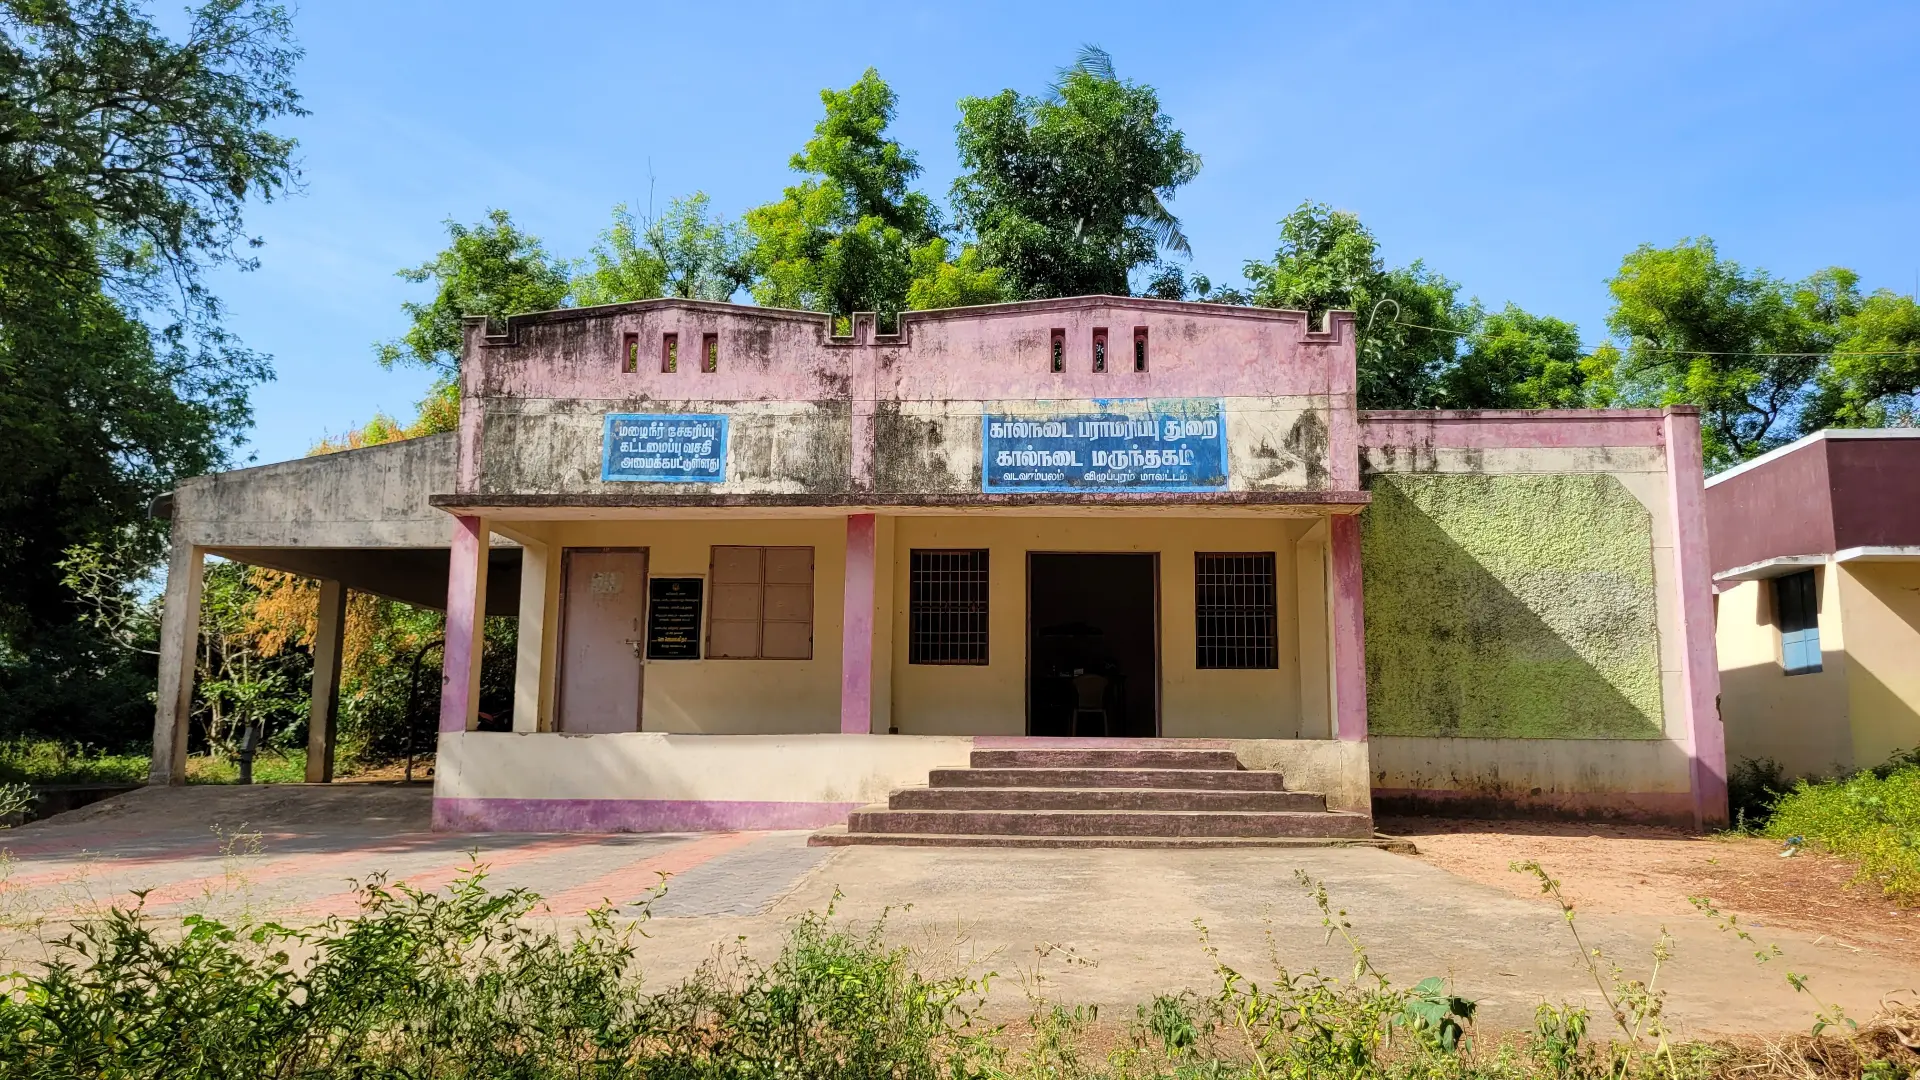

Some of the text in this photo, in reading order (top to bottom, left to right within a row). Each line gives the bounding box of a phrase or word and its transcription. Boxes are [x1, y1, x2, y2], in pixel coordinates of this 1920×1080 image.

[619, 421, 715, 440] மழைநீர் சேகரிப்பு
[990, 416, 1217, 441] கால்நடை பராமரிப்பு துறை
[620, 438, 712, 456] கட்டமைப்பு வசதி
[996, 444, 1195, 469] கால்நடை மருந்தகம்
[1083, 469, 1135, 483] விழுப்புரம்
[1140, 470, 1188, 482] மாவட்டம்
